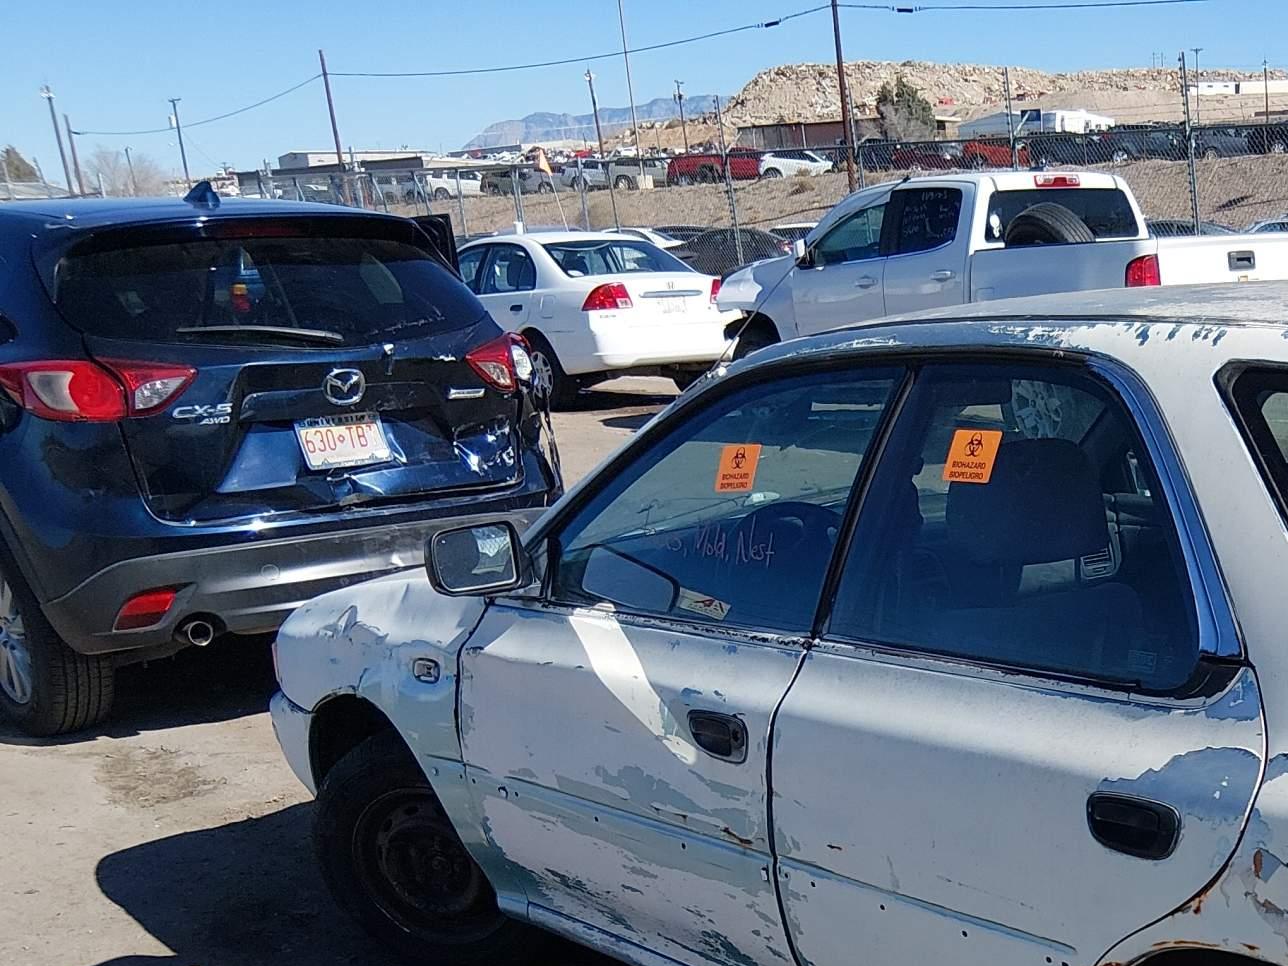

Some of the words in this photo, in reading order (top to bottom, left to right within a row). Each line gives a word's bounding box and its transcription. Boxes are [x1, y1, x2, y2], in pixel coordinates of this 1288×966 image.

[172, 403, 233, 419] CX-5
[199, 416, 230, 425] AWD
[952, 461, 987, 470] BIOHAZARD
[948, 471, 984, 480] BIOPELIGRO
[720, 482, 748, 490] BIOPELIGRO
[735, 514, 775, 569] Nest
